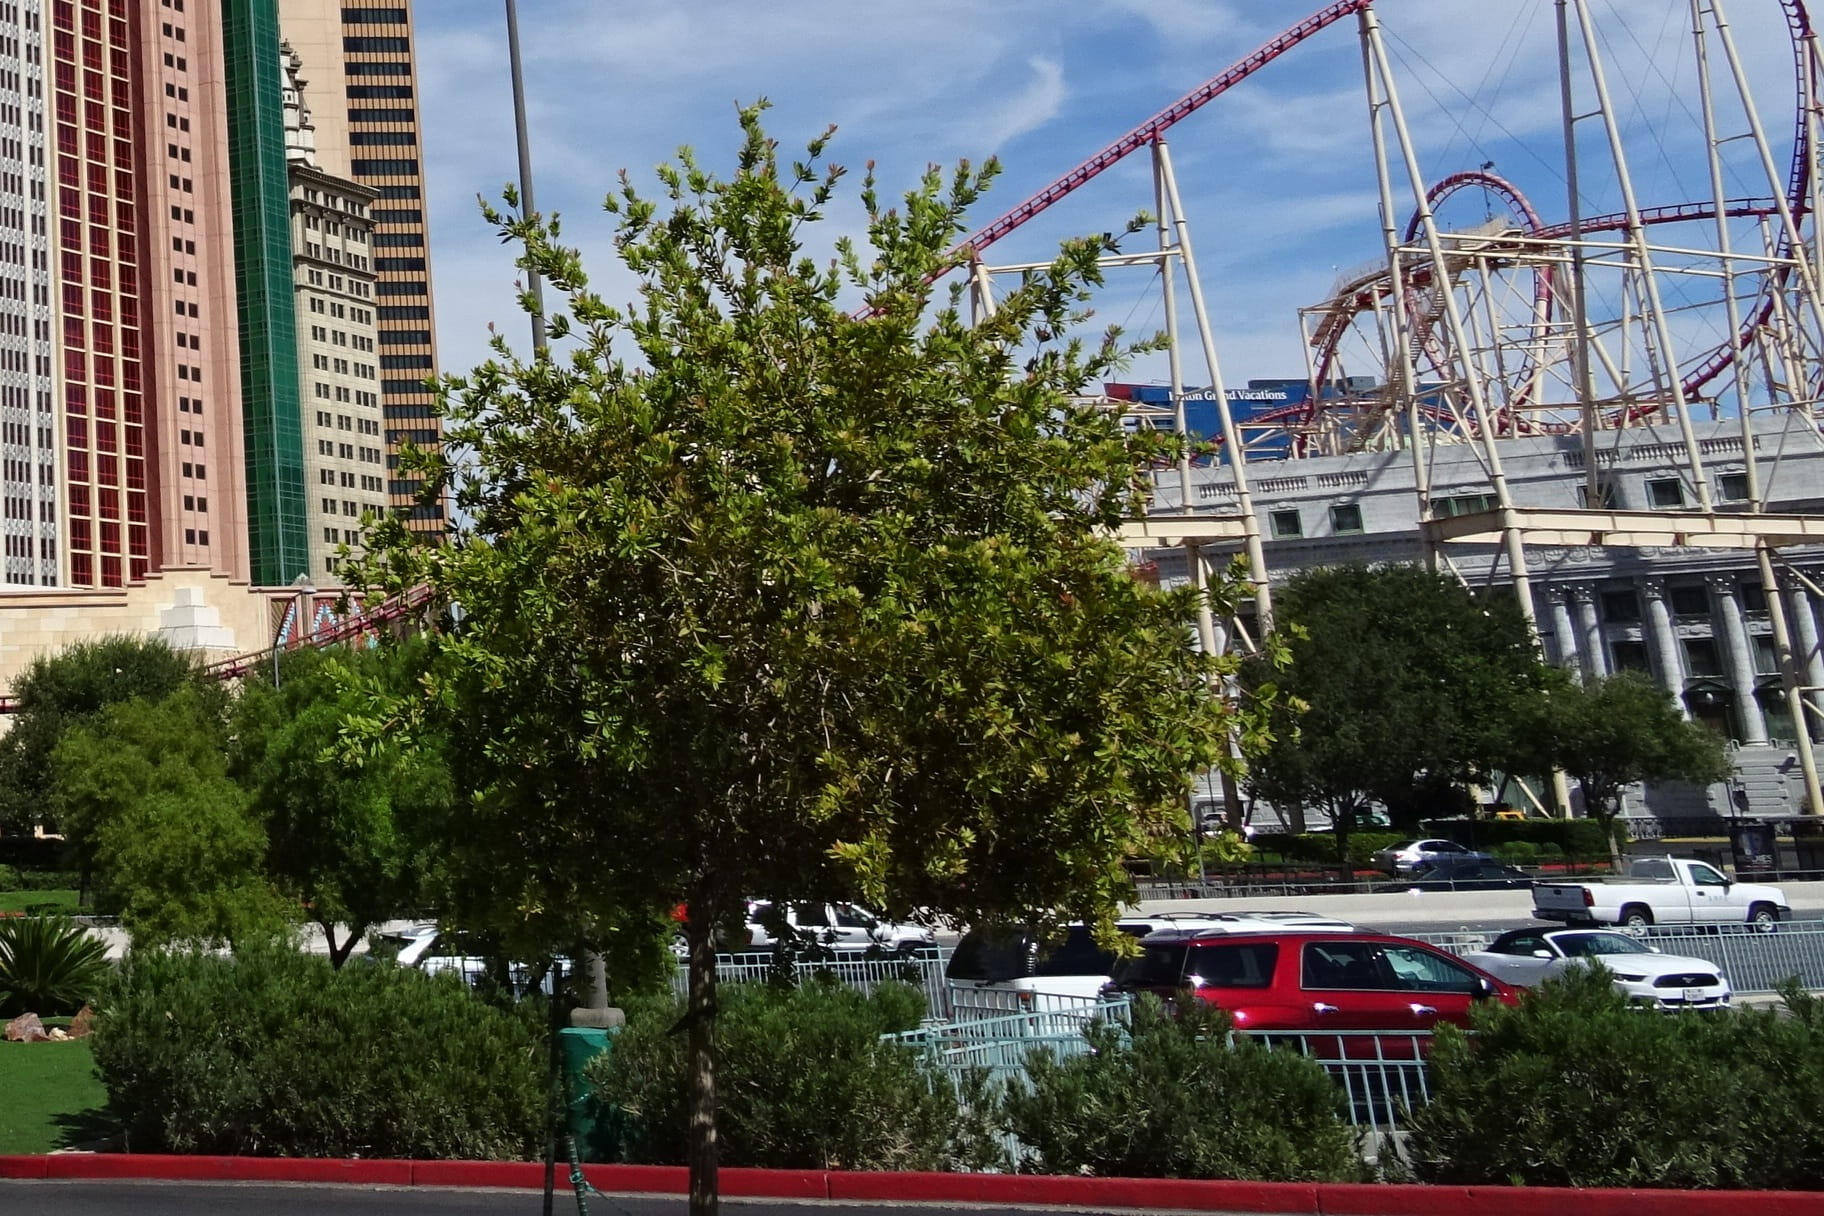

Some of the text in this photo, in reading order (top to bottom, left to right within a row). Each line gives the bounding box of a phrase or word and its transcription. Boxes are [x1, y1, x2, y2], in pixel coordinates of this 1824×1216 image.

[1168, 389, 1287, 401] lton Grnd Vacations
